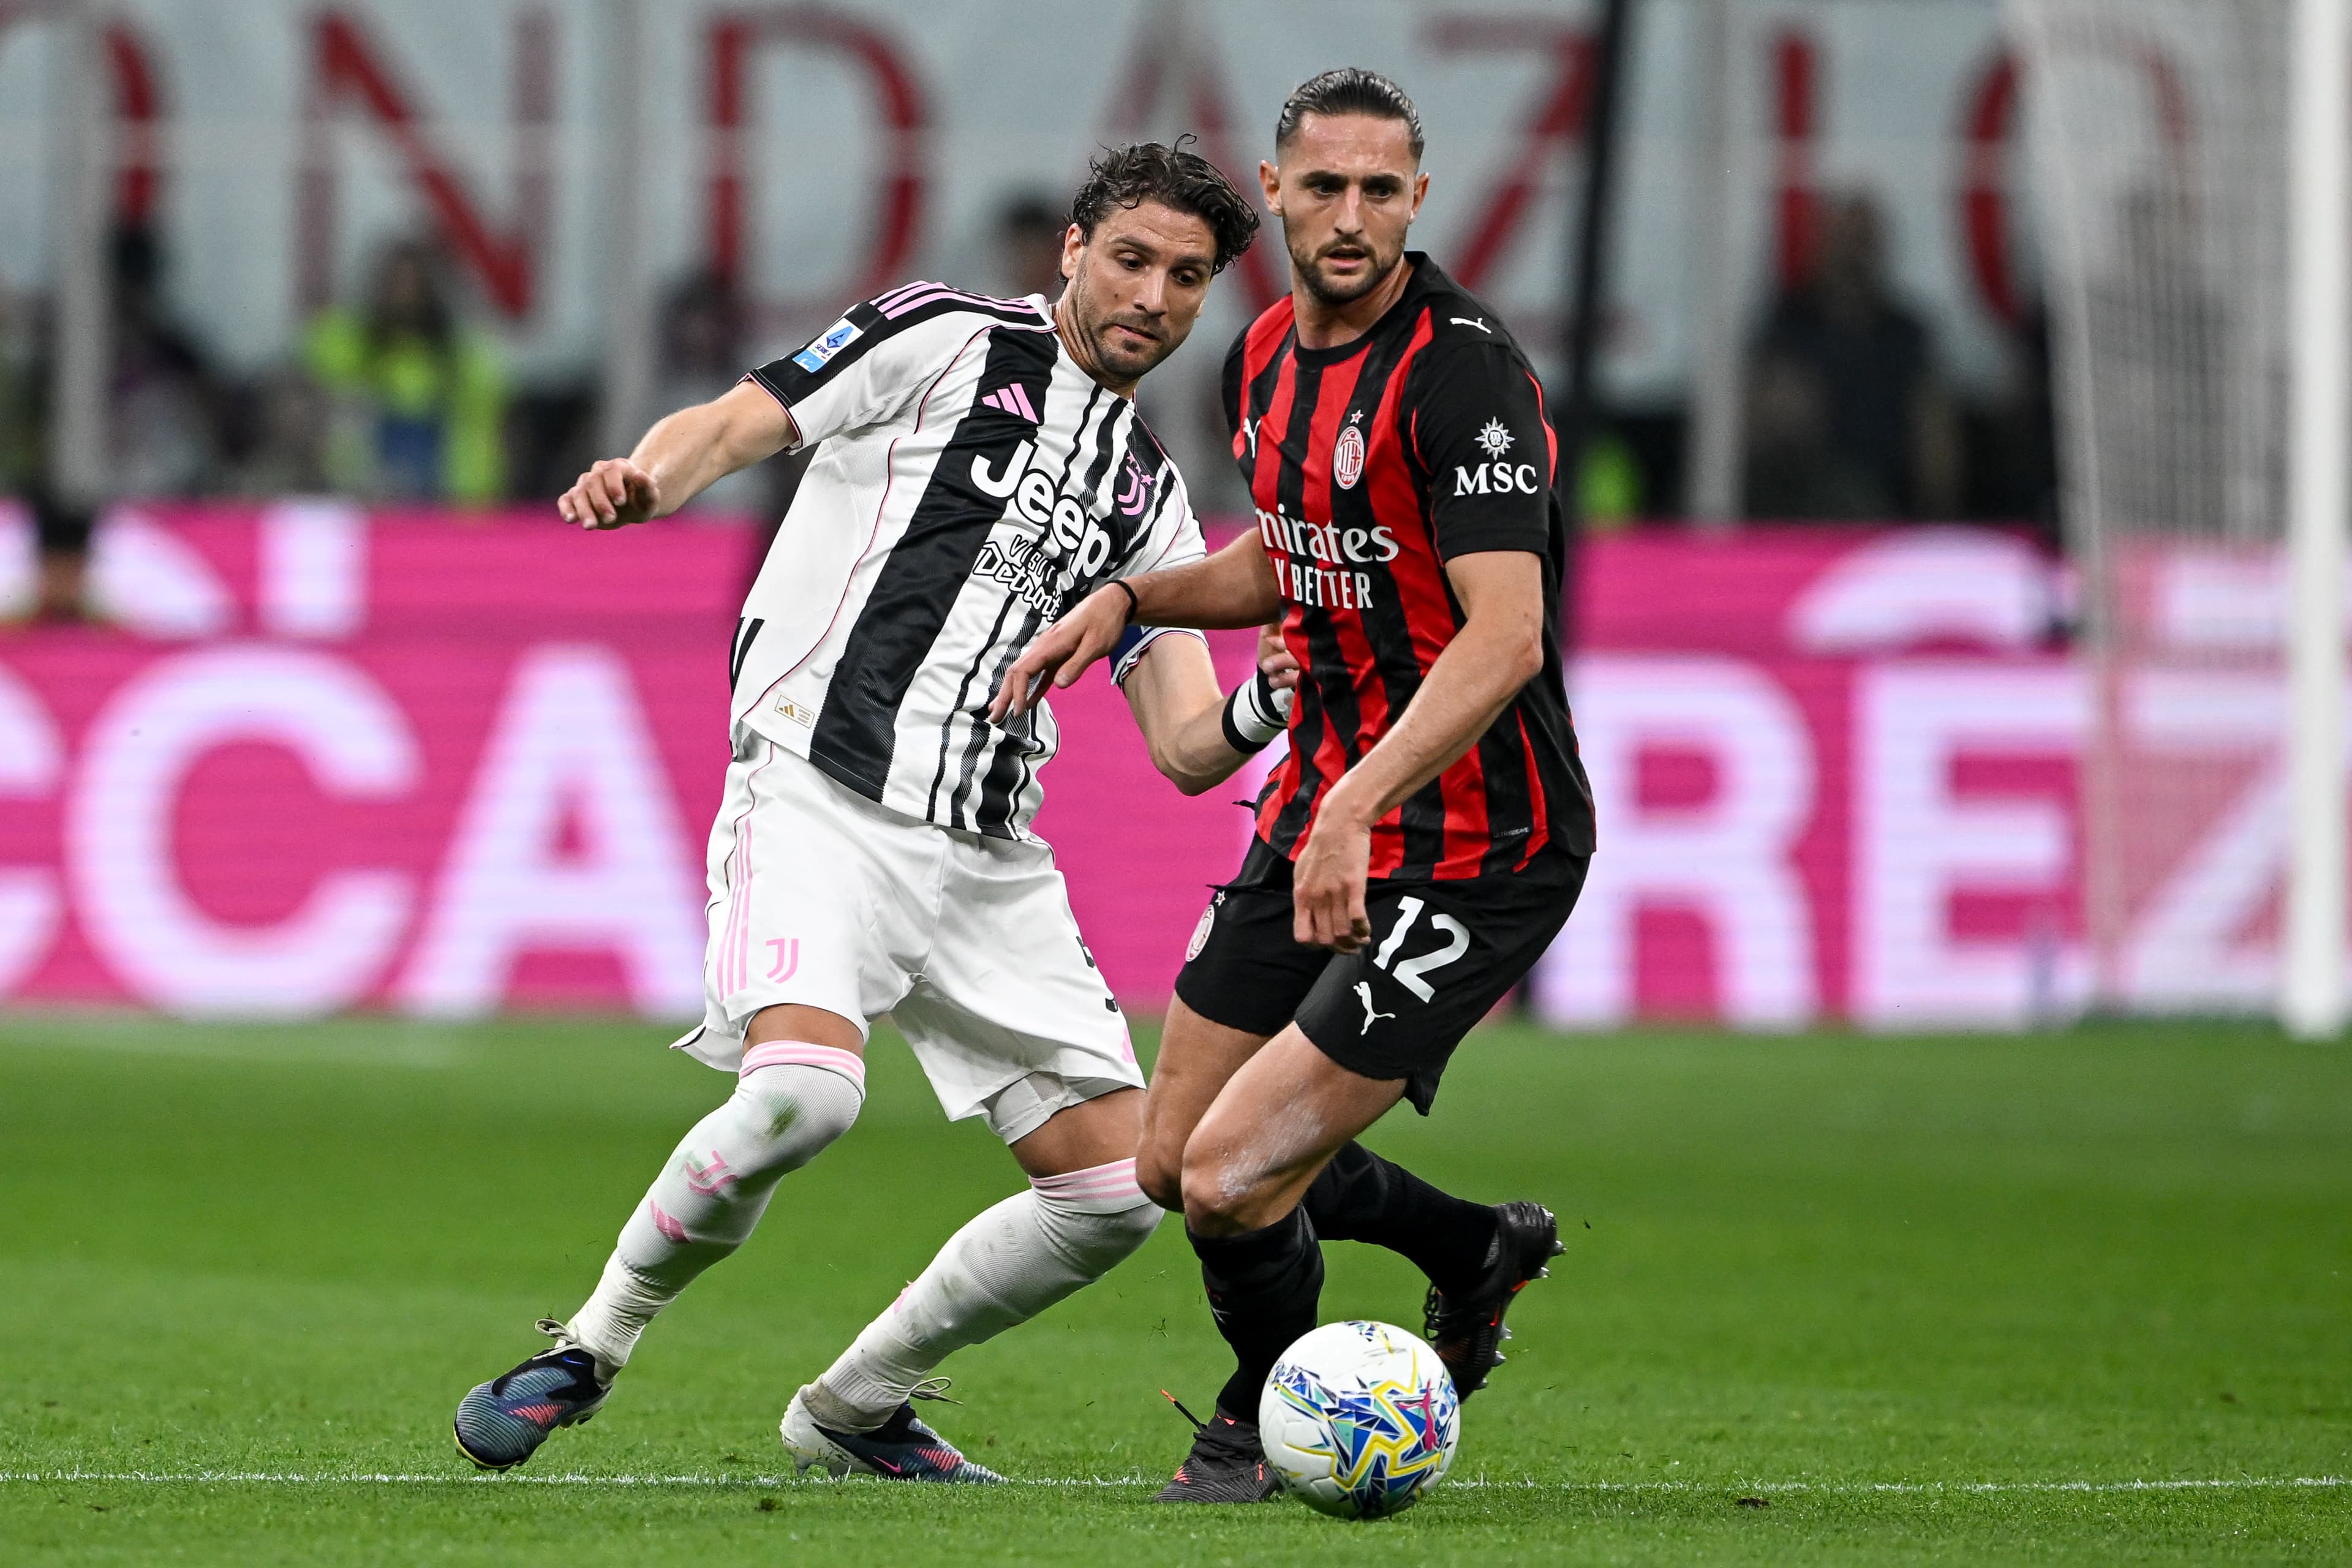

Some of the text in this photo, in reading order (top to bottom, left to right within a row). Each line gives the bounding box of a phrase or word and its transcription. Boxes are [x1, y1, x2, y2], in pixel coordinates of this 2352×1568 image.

[970, 439, 1111, 579] Jeep
[1453, 462, 1538, 496] MSC
[1009, 535, 1057, 582] VISIT
[1256, 503, 1399, 564] mirates
[1272, 557, 1374, 609] Y BETTER
[0, 646, 714, 1020] CA
[1372, 895, 1470, 1004] 12
